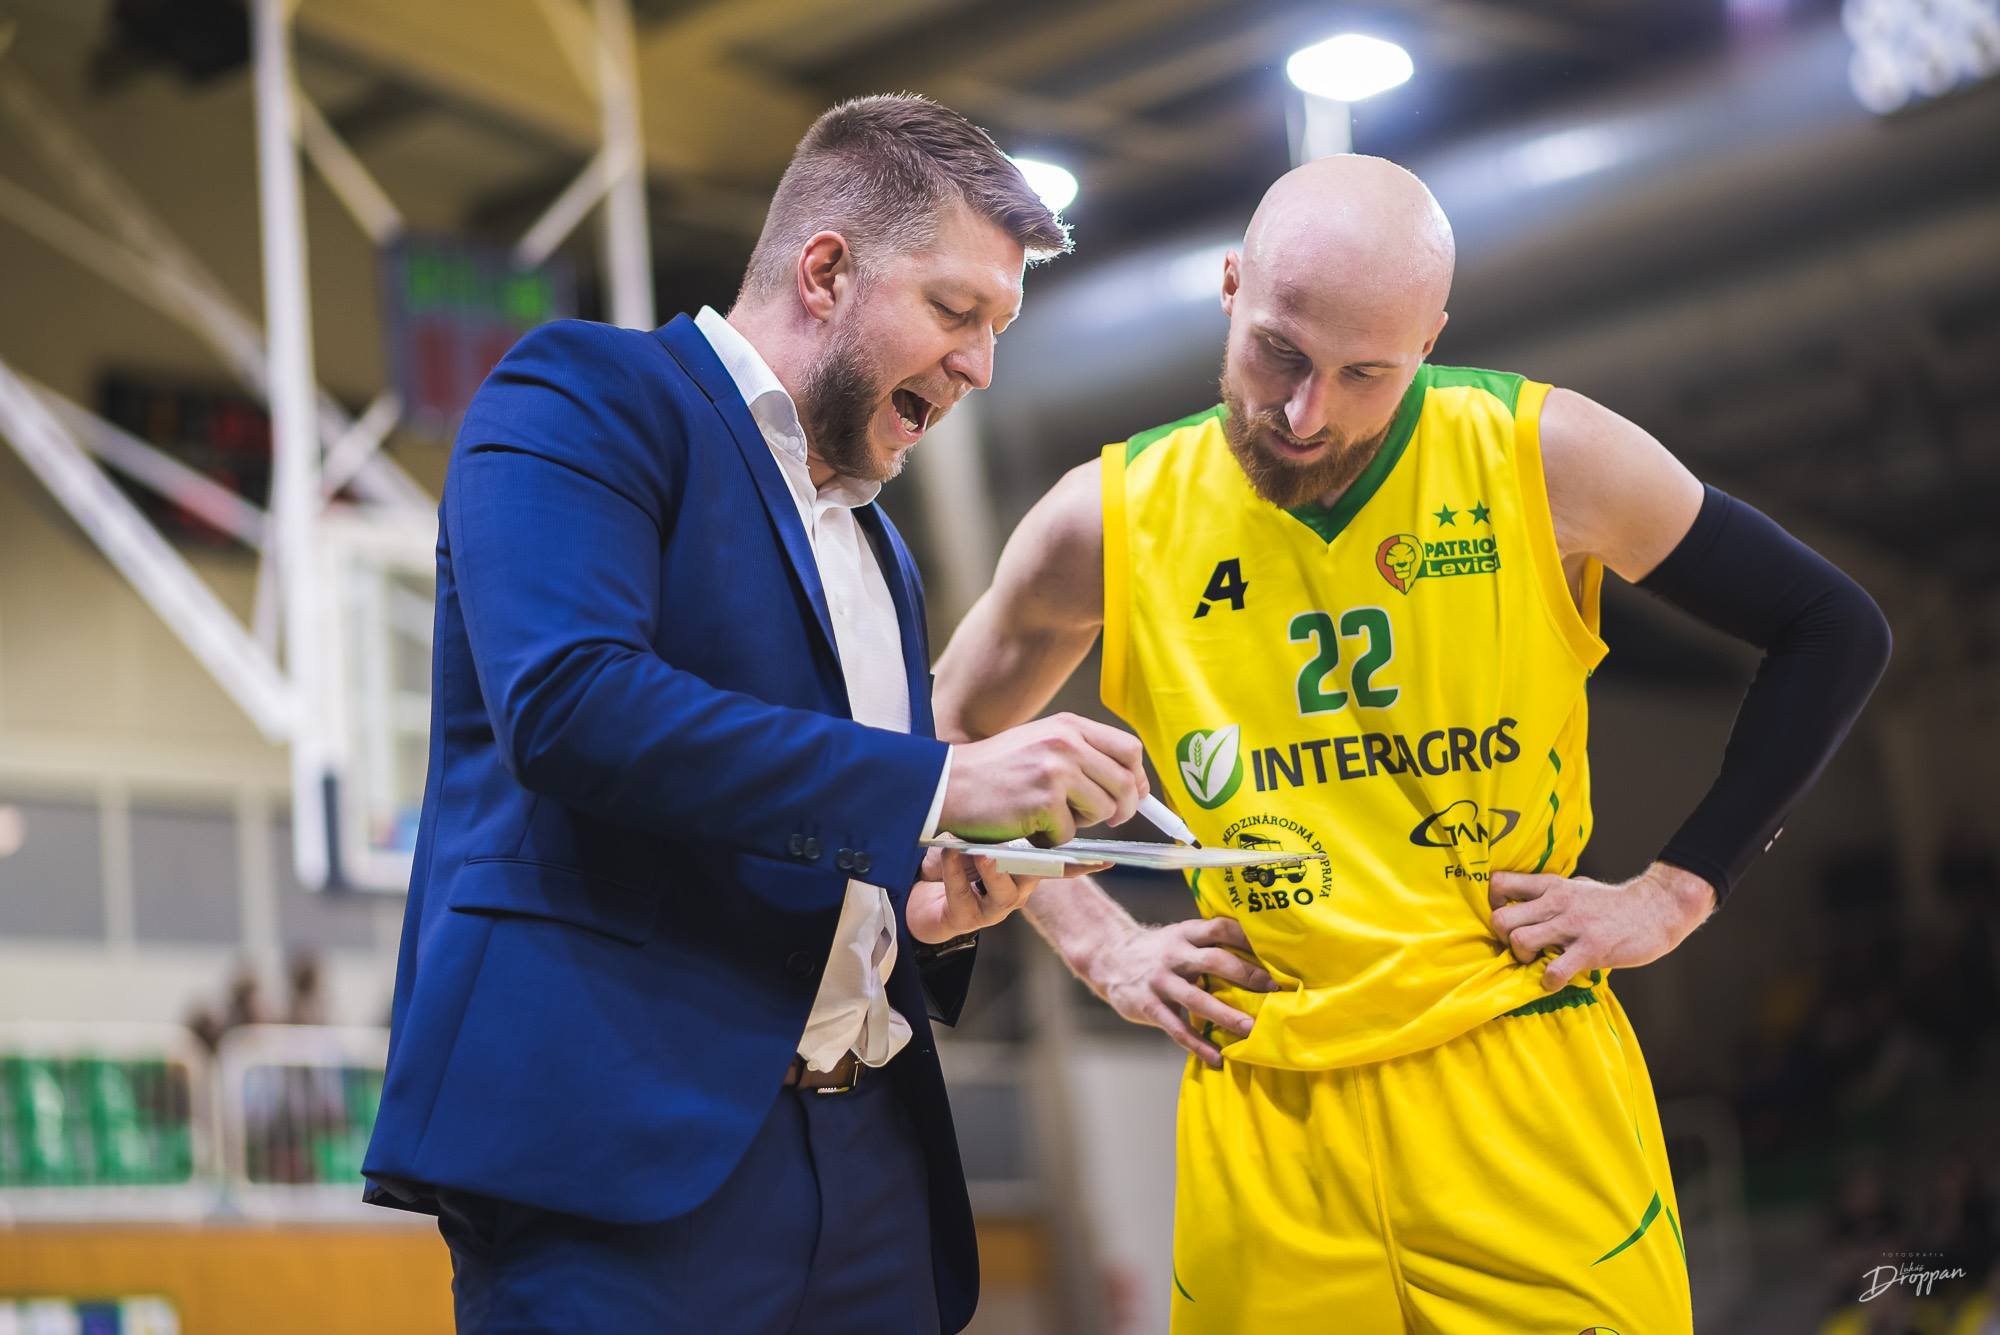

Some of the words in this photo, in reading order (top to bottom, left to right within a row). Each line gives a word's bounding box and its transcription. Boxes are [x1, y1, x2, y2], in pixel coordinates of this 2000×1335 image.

[1424, 534, 1497, 558] PATRIO
[1425, 557, 1499, 577] Levic
[1288, 605, 1400, 718] 22
[1251, 716, 1521, 792] INTERAGROS
[1247, 886, 1314, 913] ŠEBO
